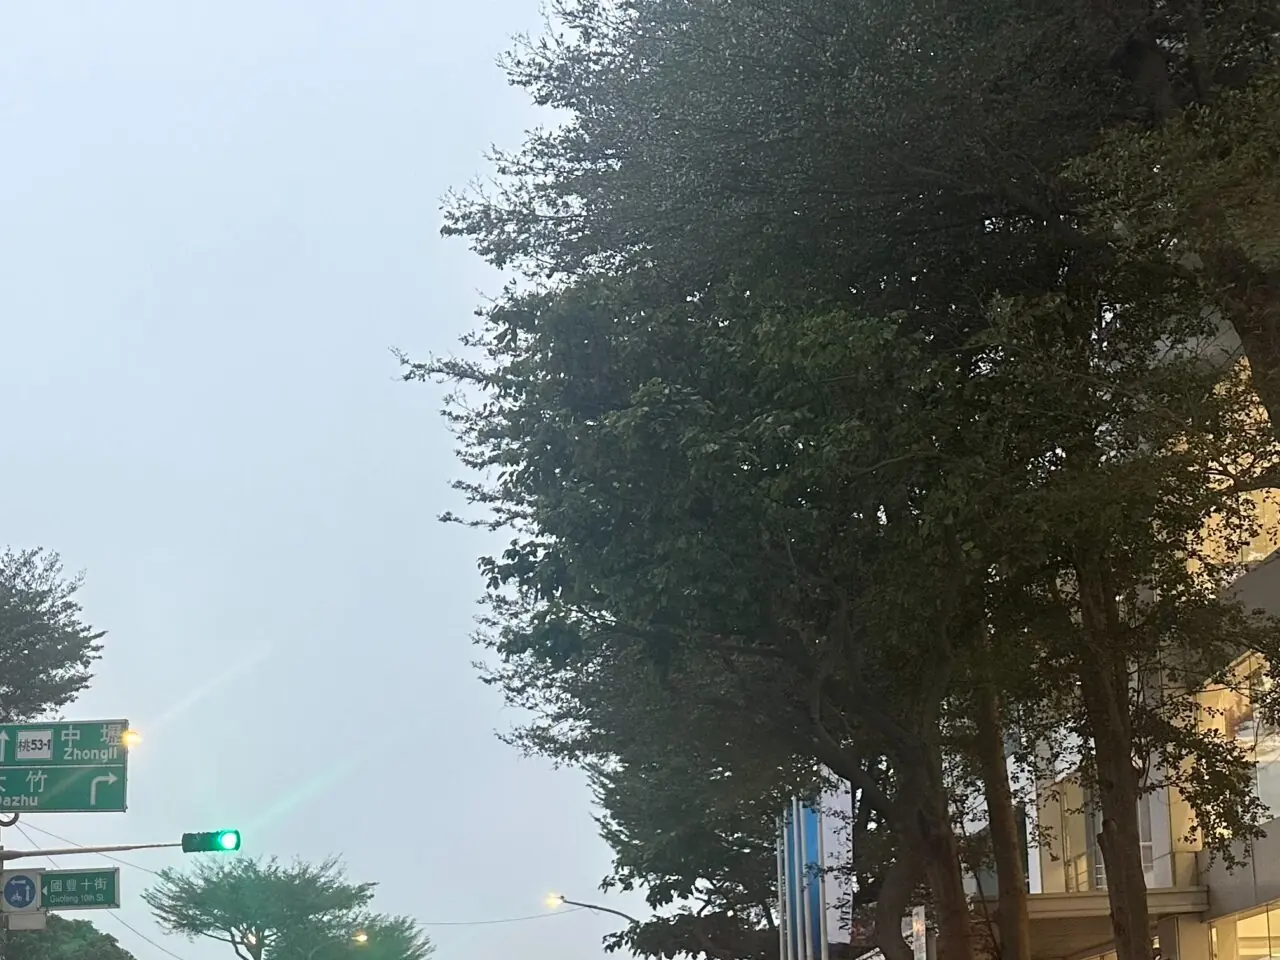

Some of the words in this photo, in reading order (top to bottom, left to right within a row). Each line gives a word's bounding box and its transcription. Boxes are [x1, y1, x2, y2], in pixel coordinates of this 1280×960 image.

[61, 724, 123, 748] 中壢
[19, 738, 51, 752] 桃53-1
[64, 747, 118, 763] Zhongli
[50, 877, 108, 893] 國豐十街
